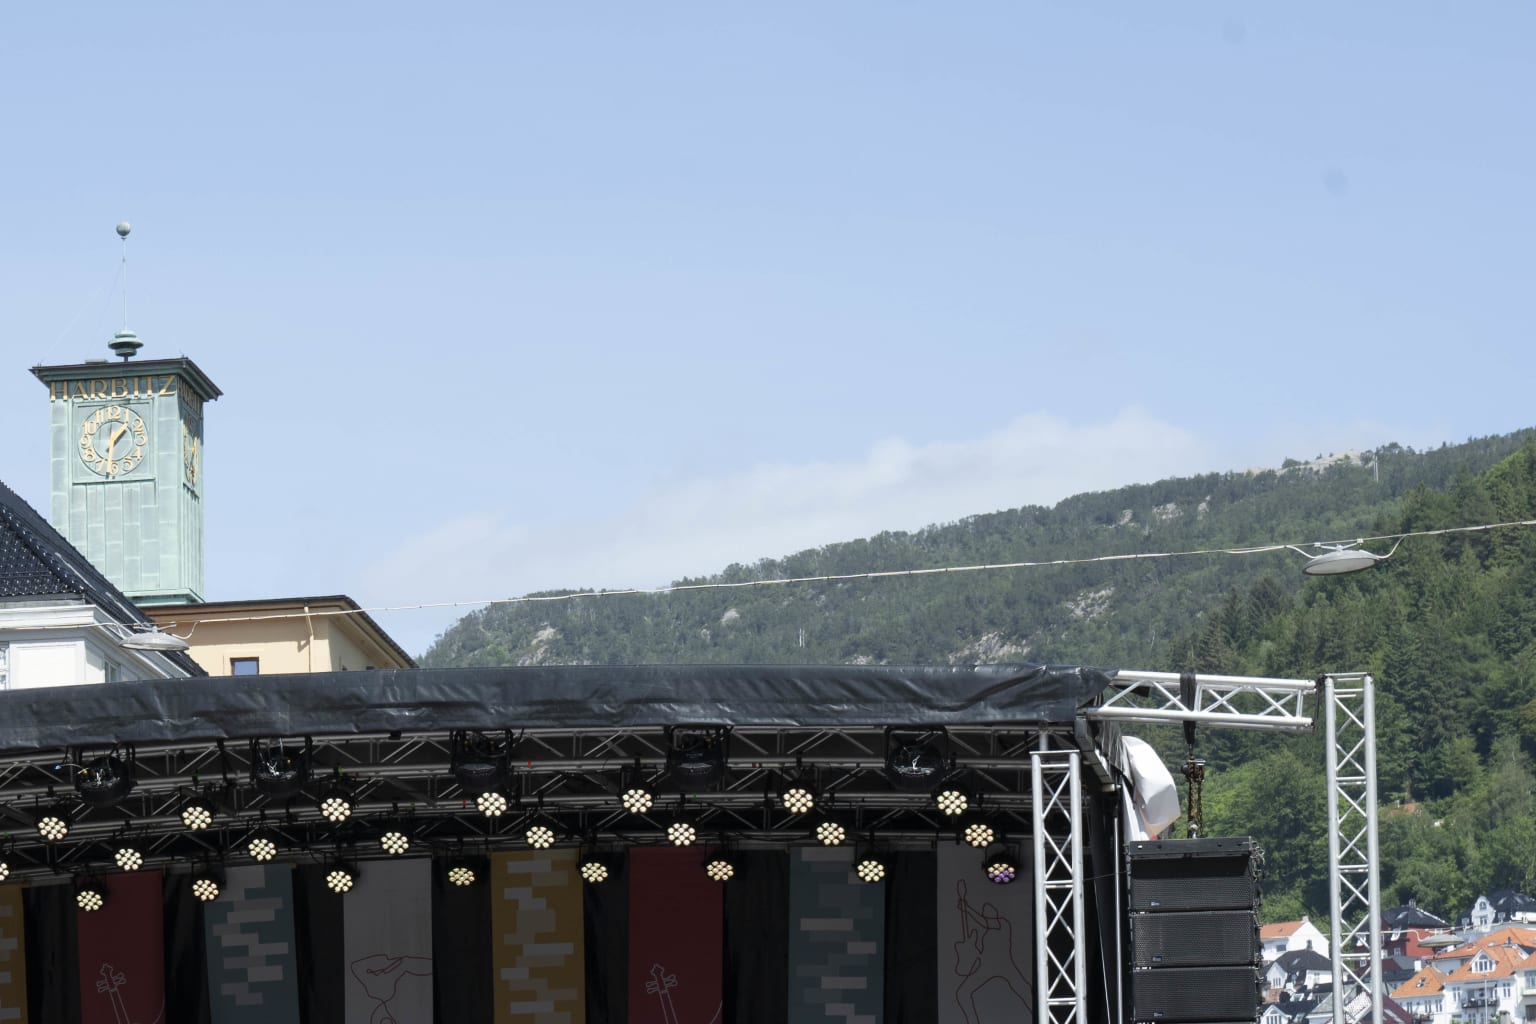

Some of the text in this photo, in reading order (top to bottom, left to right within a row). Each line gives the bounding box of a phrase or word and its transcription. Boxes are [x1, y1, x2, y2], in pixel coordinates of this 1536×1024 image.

[50, 375, 176, 401] HARBITZ
[95, 410, 104, 424] 11
[107, 406, 120, 420] 12
[82, 421, 97, 435] 10
[132, 419, 143, 432] 2
[80, 435, 91, 449] 9
[134, 433, 147, 446] 3
[84, 448, 96, 462] 8
[131, 446, 143, 461] 4
[96, 459, 107, 472] 7
[122, 457, 134, 471] 5
